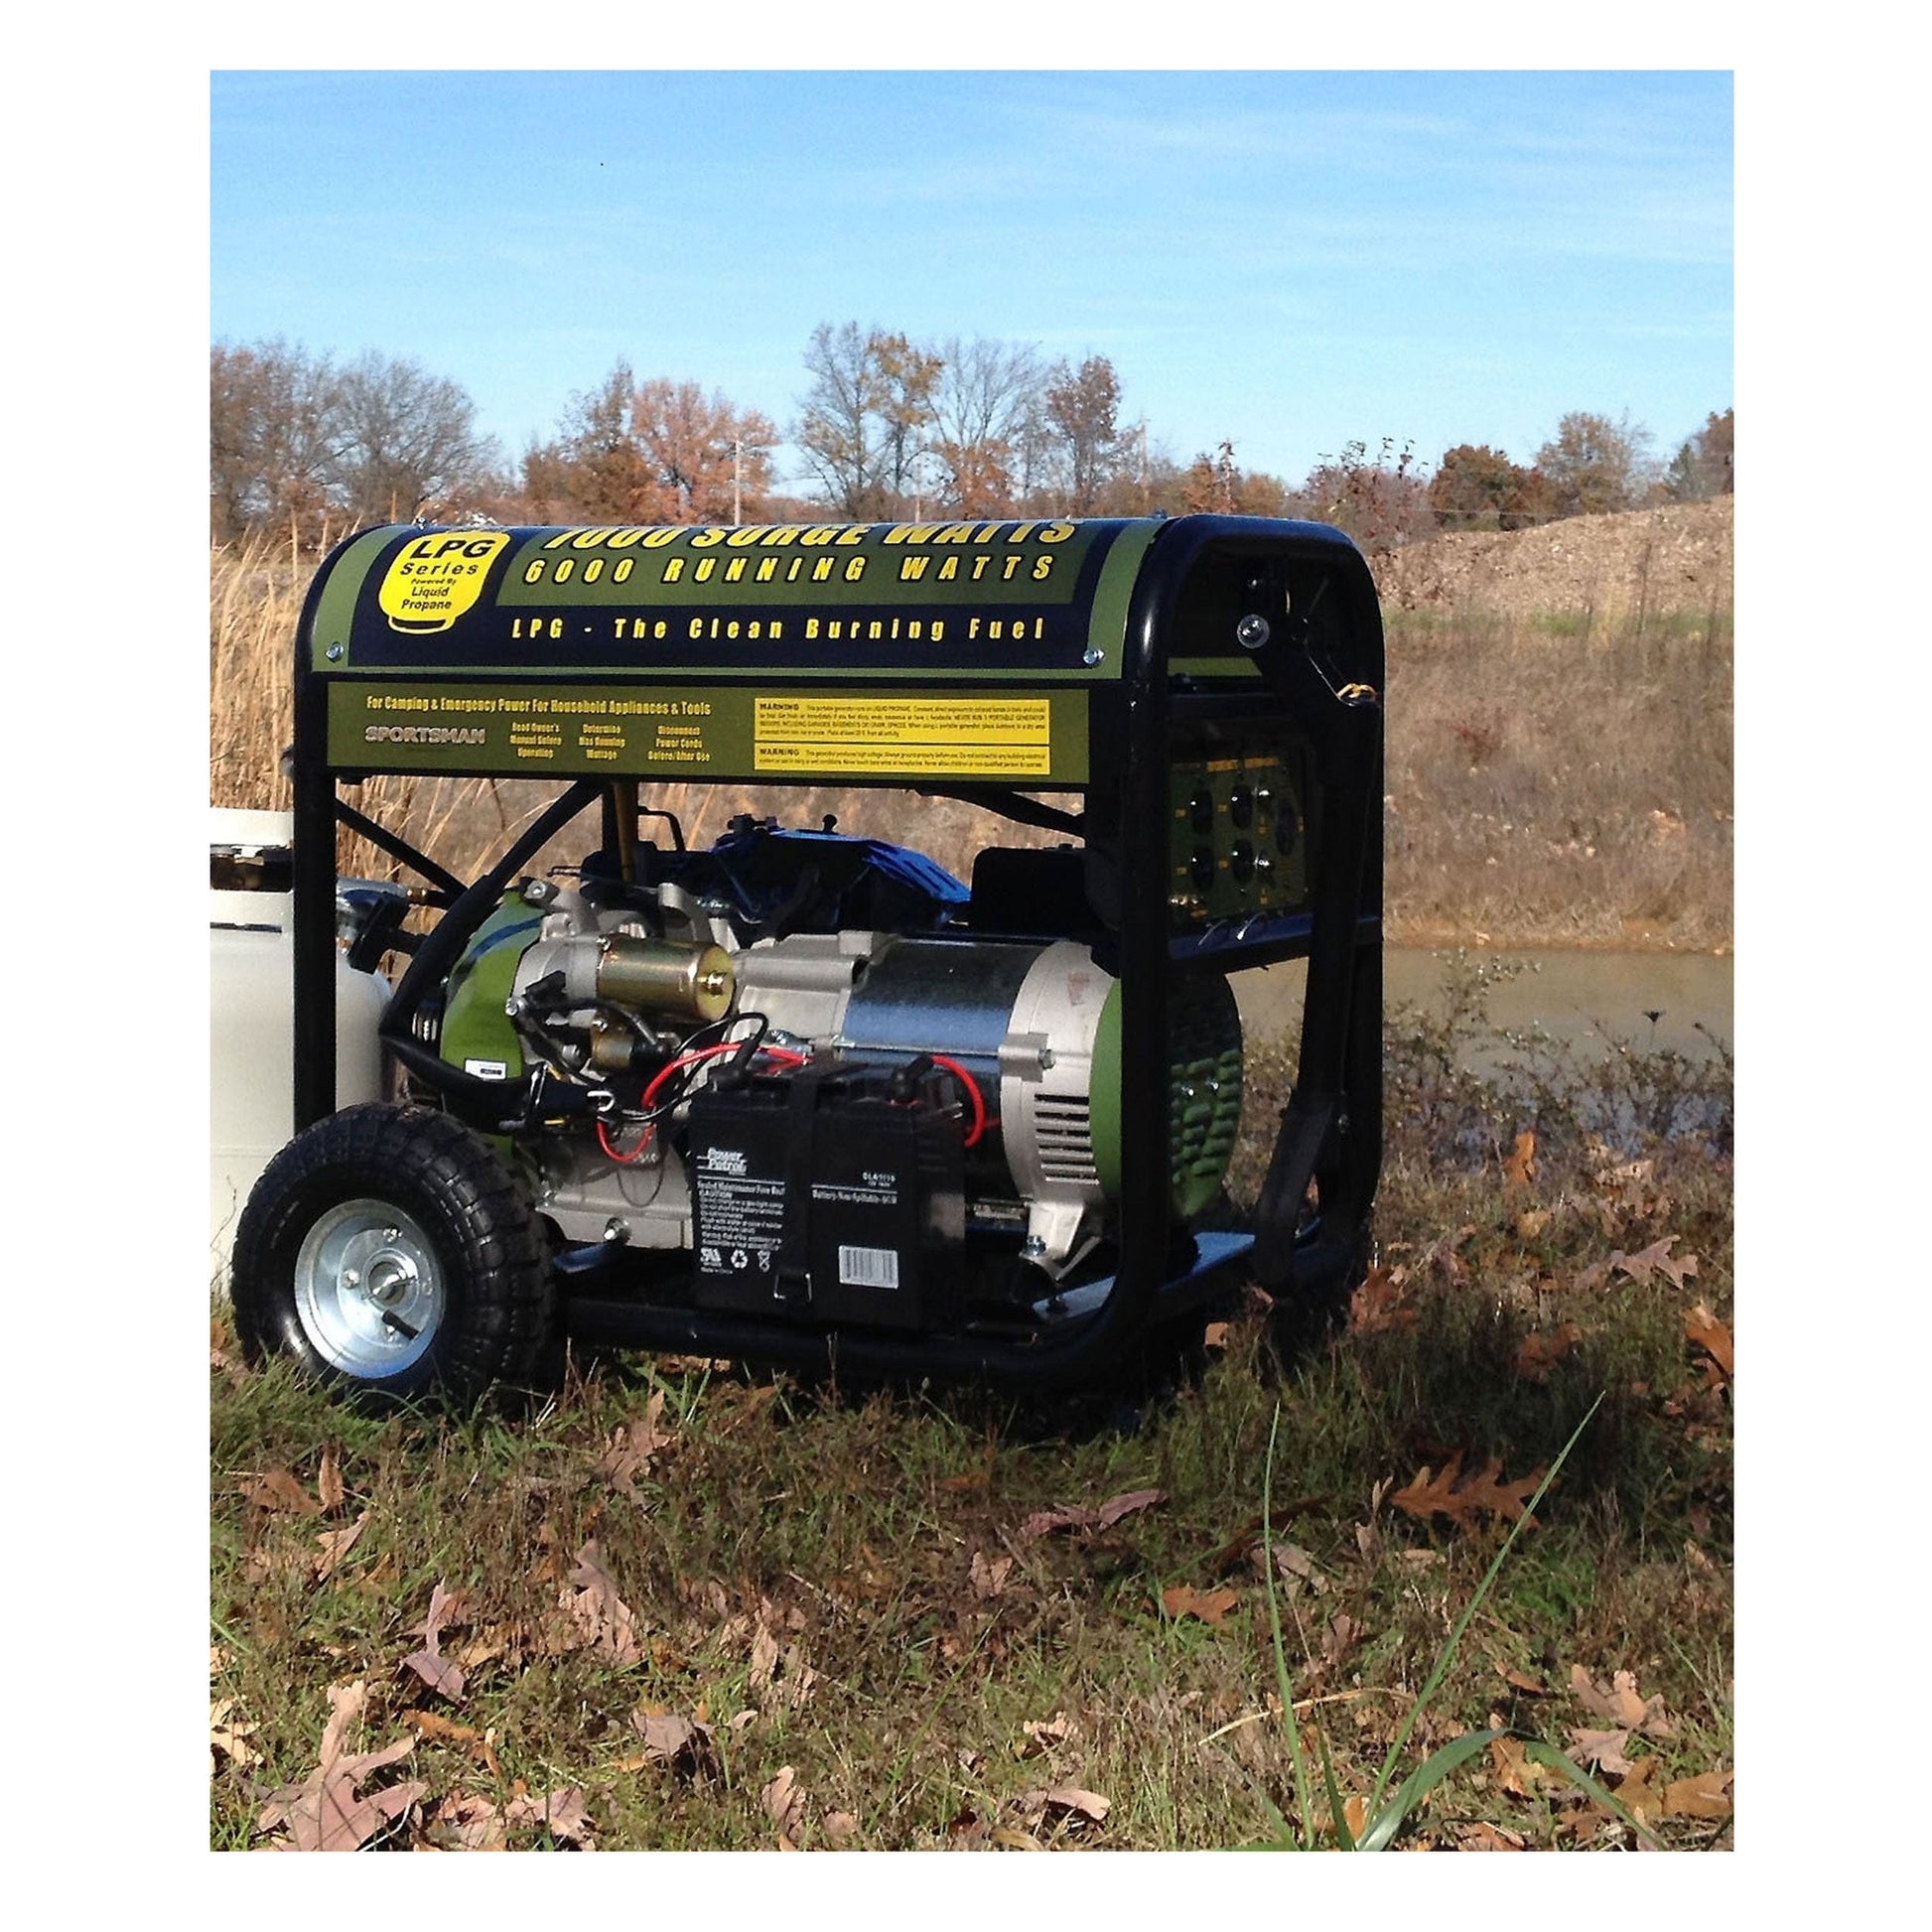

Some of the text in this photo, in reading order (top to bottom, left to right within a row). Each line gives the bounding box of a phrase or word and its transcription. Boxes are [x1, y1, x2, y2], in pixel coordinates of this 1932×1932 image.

[883, 522, 1075, 544] WATTS
[409, 539, 496, 559] LPG
[400, 562, 479, 575] Series
[524, 556, 1053, 584] 6000 RUNNING WATTS
[411, 586, 451, 598] Liquid
[401, 599, 452, 612] Propane
[511, 618, 564, 638] LPG
[614, 618, 667, 638] The
[689, 618, 782, 638] Clean
[805, 619, 944, 641] Burning
[968, 618, 1043, 638] Fuel
[366, 696, 711, 715] For Camping & Emergency Power For Household Appliances & Tools
[364, 726, 486, 744] SPORTSMAN
